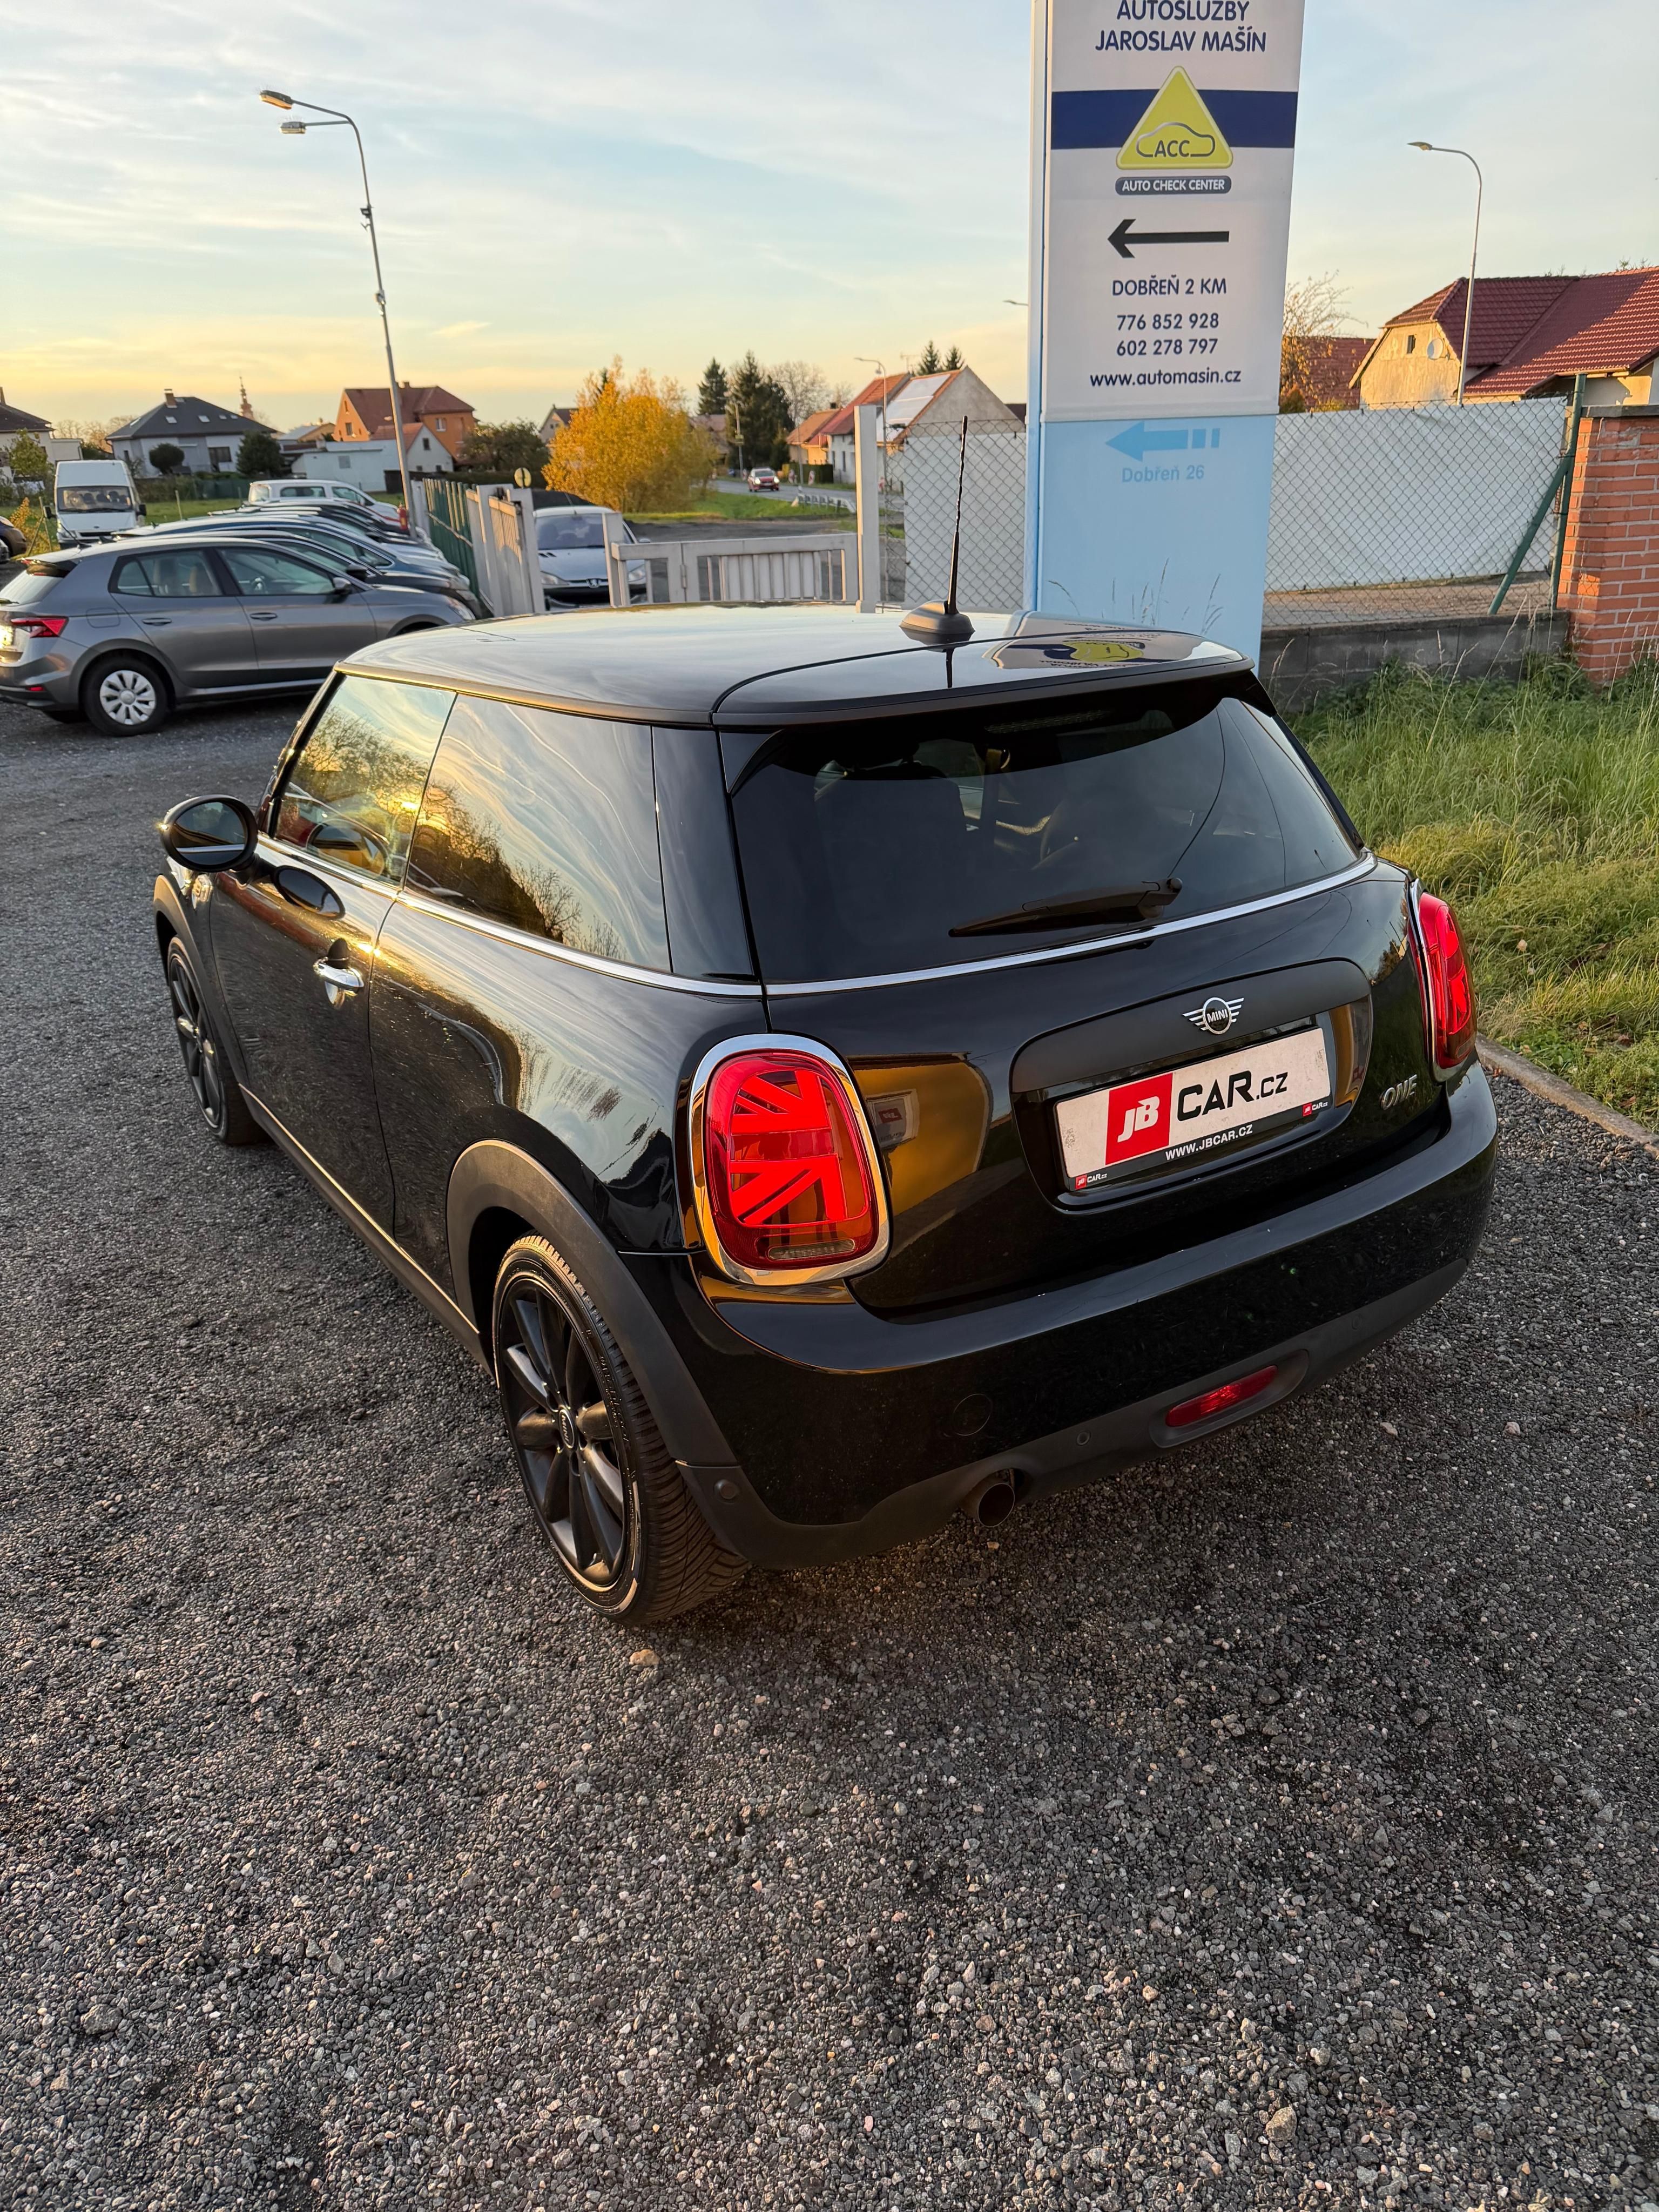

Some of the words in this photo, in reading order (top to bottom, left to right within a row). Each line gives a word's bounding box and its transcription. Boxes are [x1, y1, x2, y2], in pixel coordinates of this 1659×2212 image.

[1095, 30, 1196, 51] JAROSLAV
[1202, 26, 1266, 52] MAŠÍN
[1155, 140, 1190, 157] ACC
[1122, 180, 1151, 191] AUTO
[1153, 179, 1186, 191] CHECK
[1189, 179, 1225, 191] CENTER
[1112, 274, 1179, 296] DOBŘEŇ
[1185, 278, 1194, 294] 2
[1201, 278, 1227, 294] KM
[1116, 314, 1146, 331] 776
[1152, 313, 1183, 330] 852
[1189, 313, 1219, 329] 928
[1116, 340, 1147, 356] 602
[1153, 339, 1183, 355] 278
[1189, 338, 1218, 354] 797
[1090, 367, 1242, 387] www.automasin.cz
[1122, 466, 1179, 483] Dobřeň
[1186, 465, 1205, 480] 26
[1206, 1009, 1228, 1023] MINI
[1380, 1074, 1417, 1110] ONE
[1165, 1124, 1253, 1161] WWW.JBCAR.CZ
